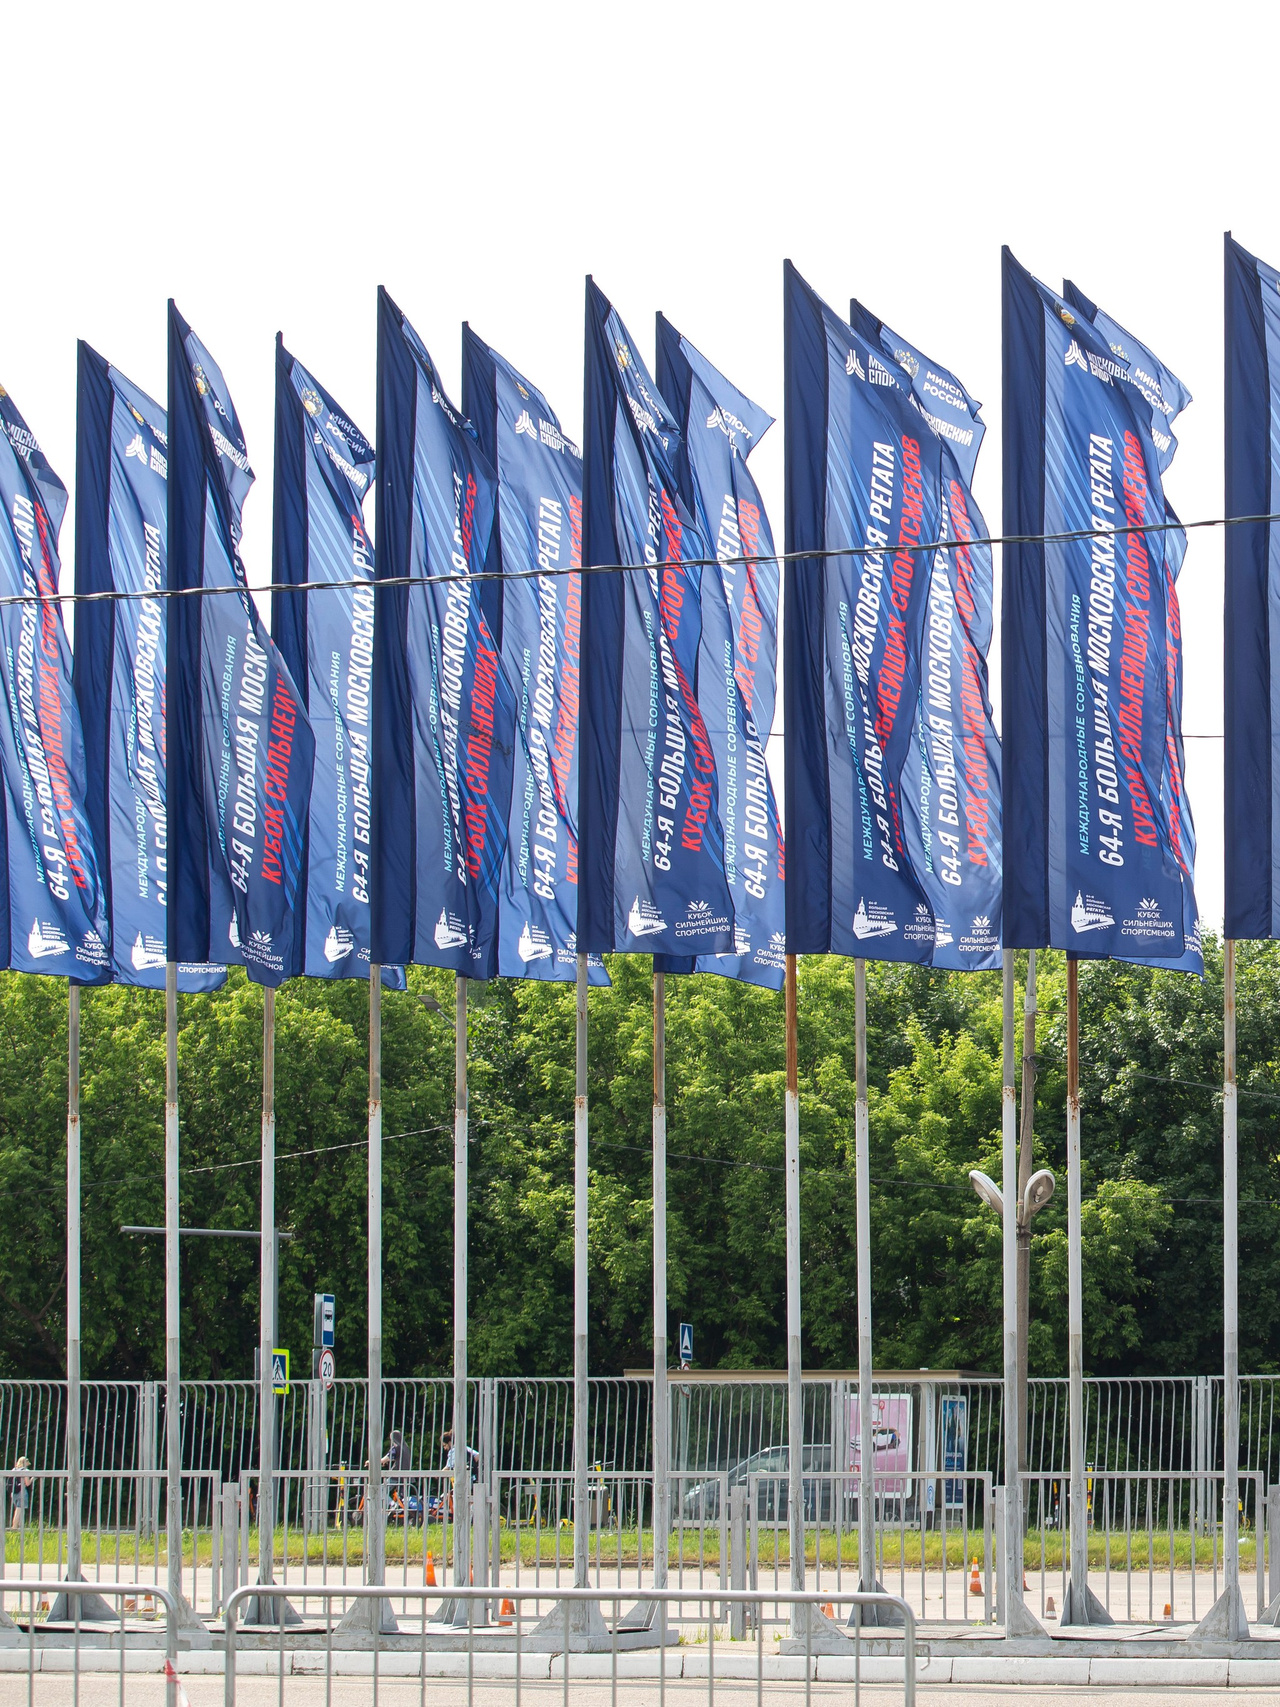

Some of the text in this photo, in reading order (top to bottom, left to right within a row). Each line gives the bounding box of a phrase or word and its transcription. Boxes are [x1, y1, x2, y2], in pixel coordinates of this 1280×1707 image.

[923, 382, 968, 412] РОССИИ
[326, 421, 366, 456] РОССИИ
[540, 430, 565, 454] СПОРТ
[870, 442, 894, 524] РЕГАТА
[891, 435, 923, 611] СПОРТСМЕНОВ
[137, 520, 164, 750] МОСКОВСКАЯ РЕГАТА
[441, 550, 473, 710] МОСКОВСКАЯ
[839, 601, 855, 720] СОРЕВНОВАНИЯ
[1088, 434, 1123, 866] 64-Я БОЛЬШАЯ МОСКОВСКАЯ РЕГАТА
[1119, 431, 1157, 846] КУБОК СИЛЬНЕЙШИХ СПОРТСМЕНОВ
[17, 570, 69, 900] 64-Я МОСКОВСКАЯ
[222, 635, 236, 755] СОРЕВНОВАНИЯ
[530, 497, 565, 900] 64-Я БОЛЬШАЯ МОСКОВСКАЯ РЕГАТА
[642, 608, 658, 861] МЕЖДУНАРОДНЫЕ СОРЕВНОВАНИЯ
[928, 548, 963, 887] 64-Я БОЛЬШАЯ МОСКОВСКАЯ
[1072, 594, 1089, 854] МЕЖДУНАРОДНЫЕ СОРЕВНОВАНИЯ
[330, 651, 347, 891] МЕЖДУНАРОДНЫЕ СОРЕВНОВАНИЯ
[347, 575, 374, 904] 64-Я БОЛЬШАЯ МОСКОВСКАЯ
[465, 641, 497, 878] КУБОК СИЛЬНЕЙШИХ
[659, 694, 685, 809] БОЛЬШАЯ
[724, 640, 738, 885] МЕЖДУНАРОДНЫЕ СОРЕВНОВАНИЯ
[231, 716, 259, 893] 64-Я БОЛЬШАЯ
[262, 804, 284, 884] КУБОК
[653, 815, 676, 871] 64-Я
[682, 778, 711, 851] КУБОК
[872, 813, 899, 872] 64-Я
[966, 790, 988, 866] КУБОК
[744, 842, 769, 899] 64-Я
[247, 940, 272, 952] КУБОК
[675, 917, 729, 929] СИЛЬНЕЙШИХ
[675, 925, 731, 937] СПОРТСМЕНОВ
[687, 910, 713, 920] КУБОК
[958, 944, 1001, 952] СПОРТСМЕНОВ
[960, 936, 998, 944] СИЛЬНЕЙШИХ
[1121, 928, 1175, 938] СПОРТСМЕНОВ
[1122, 919, 1173, 929] СИЛЬНЕЙШИХ
[178, 965, 227, 974] СПОРТСМЕНОВ
[323, 1361, 332, 1377] 20
